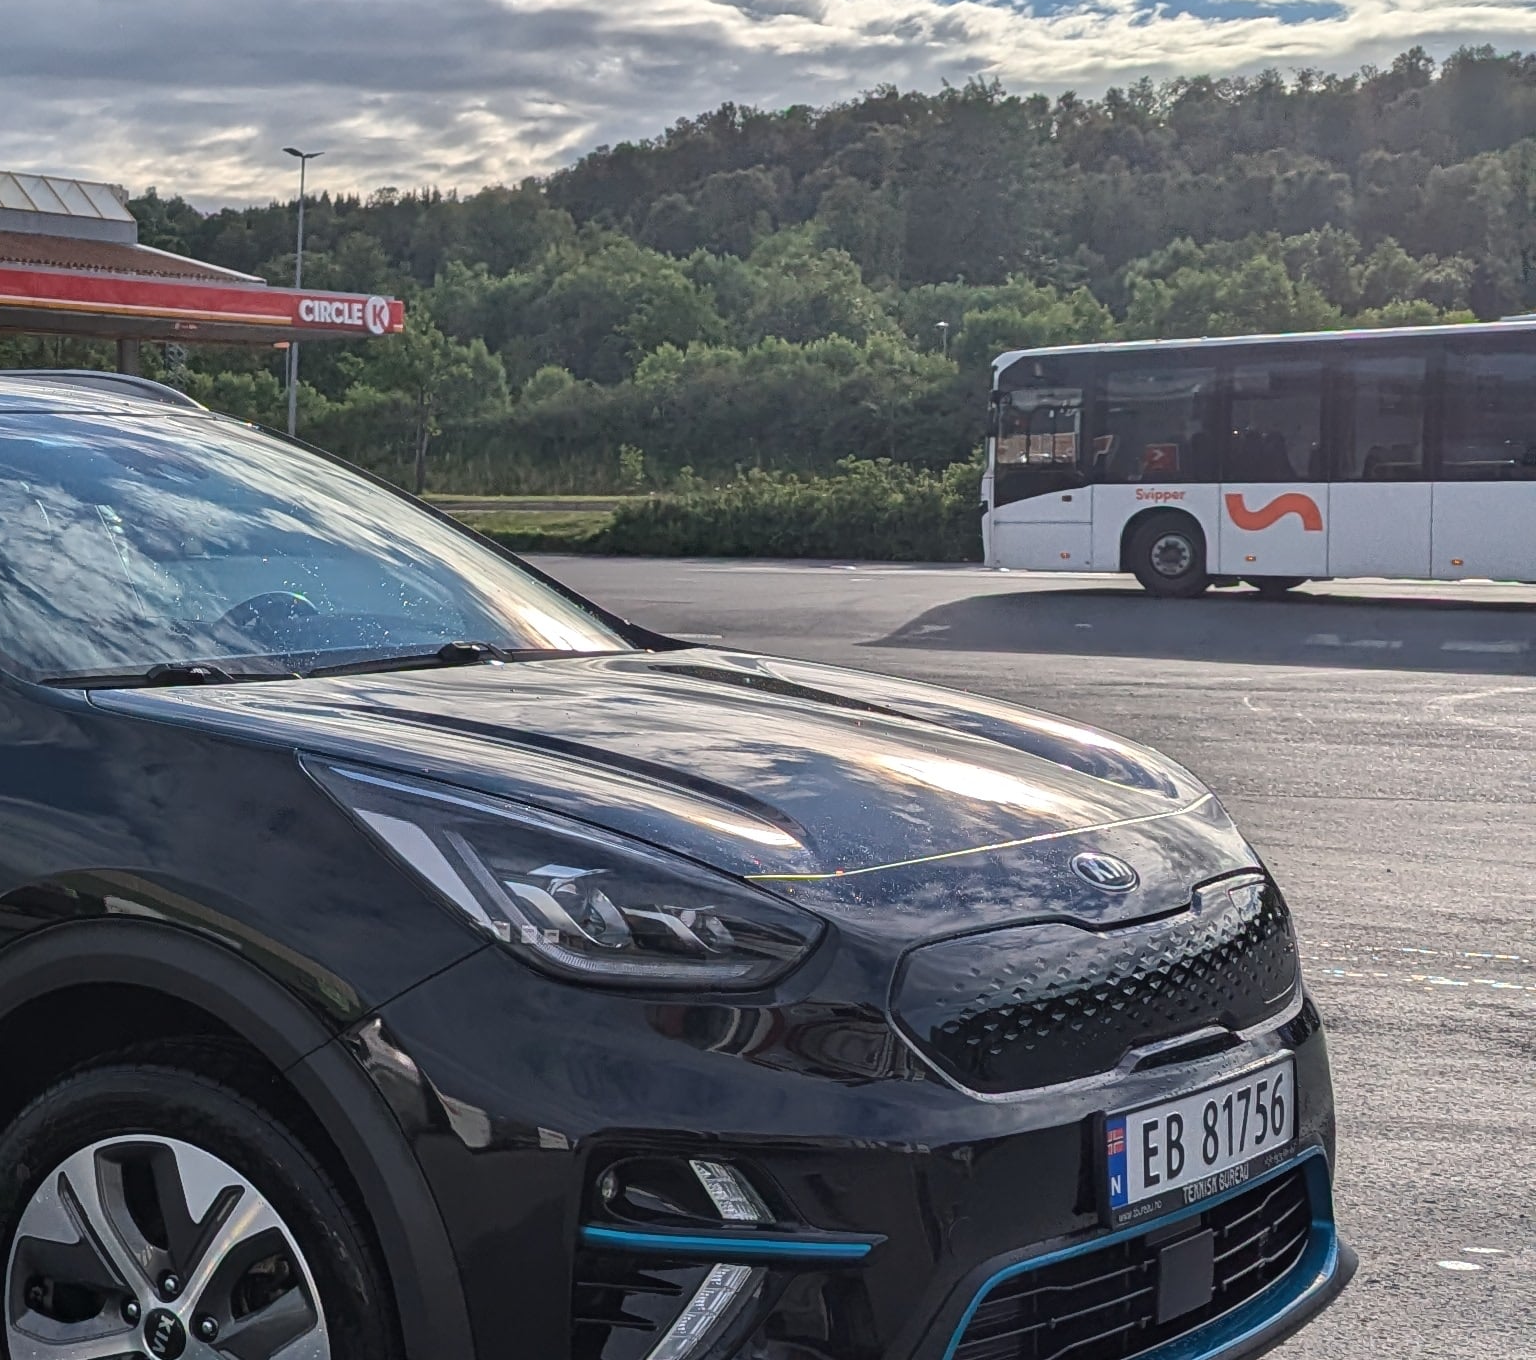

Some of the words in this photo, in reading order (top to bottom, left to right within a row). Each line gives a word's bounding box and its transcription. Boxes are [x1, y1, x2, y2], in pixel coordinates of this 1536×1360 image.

[299, 299, 363, 325] CIRCLE
[1135, 487, 1186, 503] Svipper
[1079, 857, 1132, 881] KIA
[1142, 1112, 1185, 1189] EB
[1202, 1071, 1285, 1166] 81756
[1111, 1175, 1122, 1196] N
[152, 1315, 175, 1353] KIA
